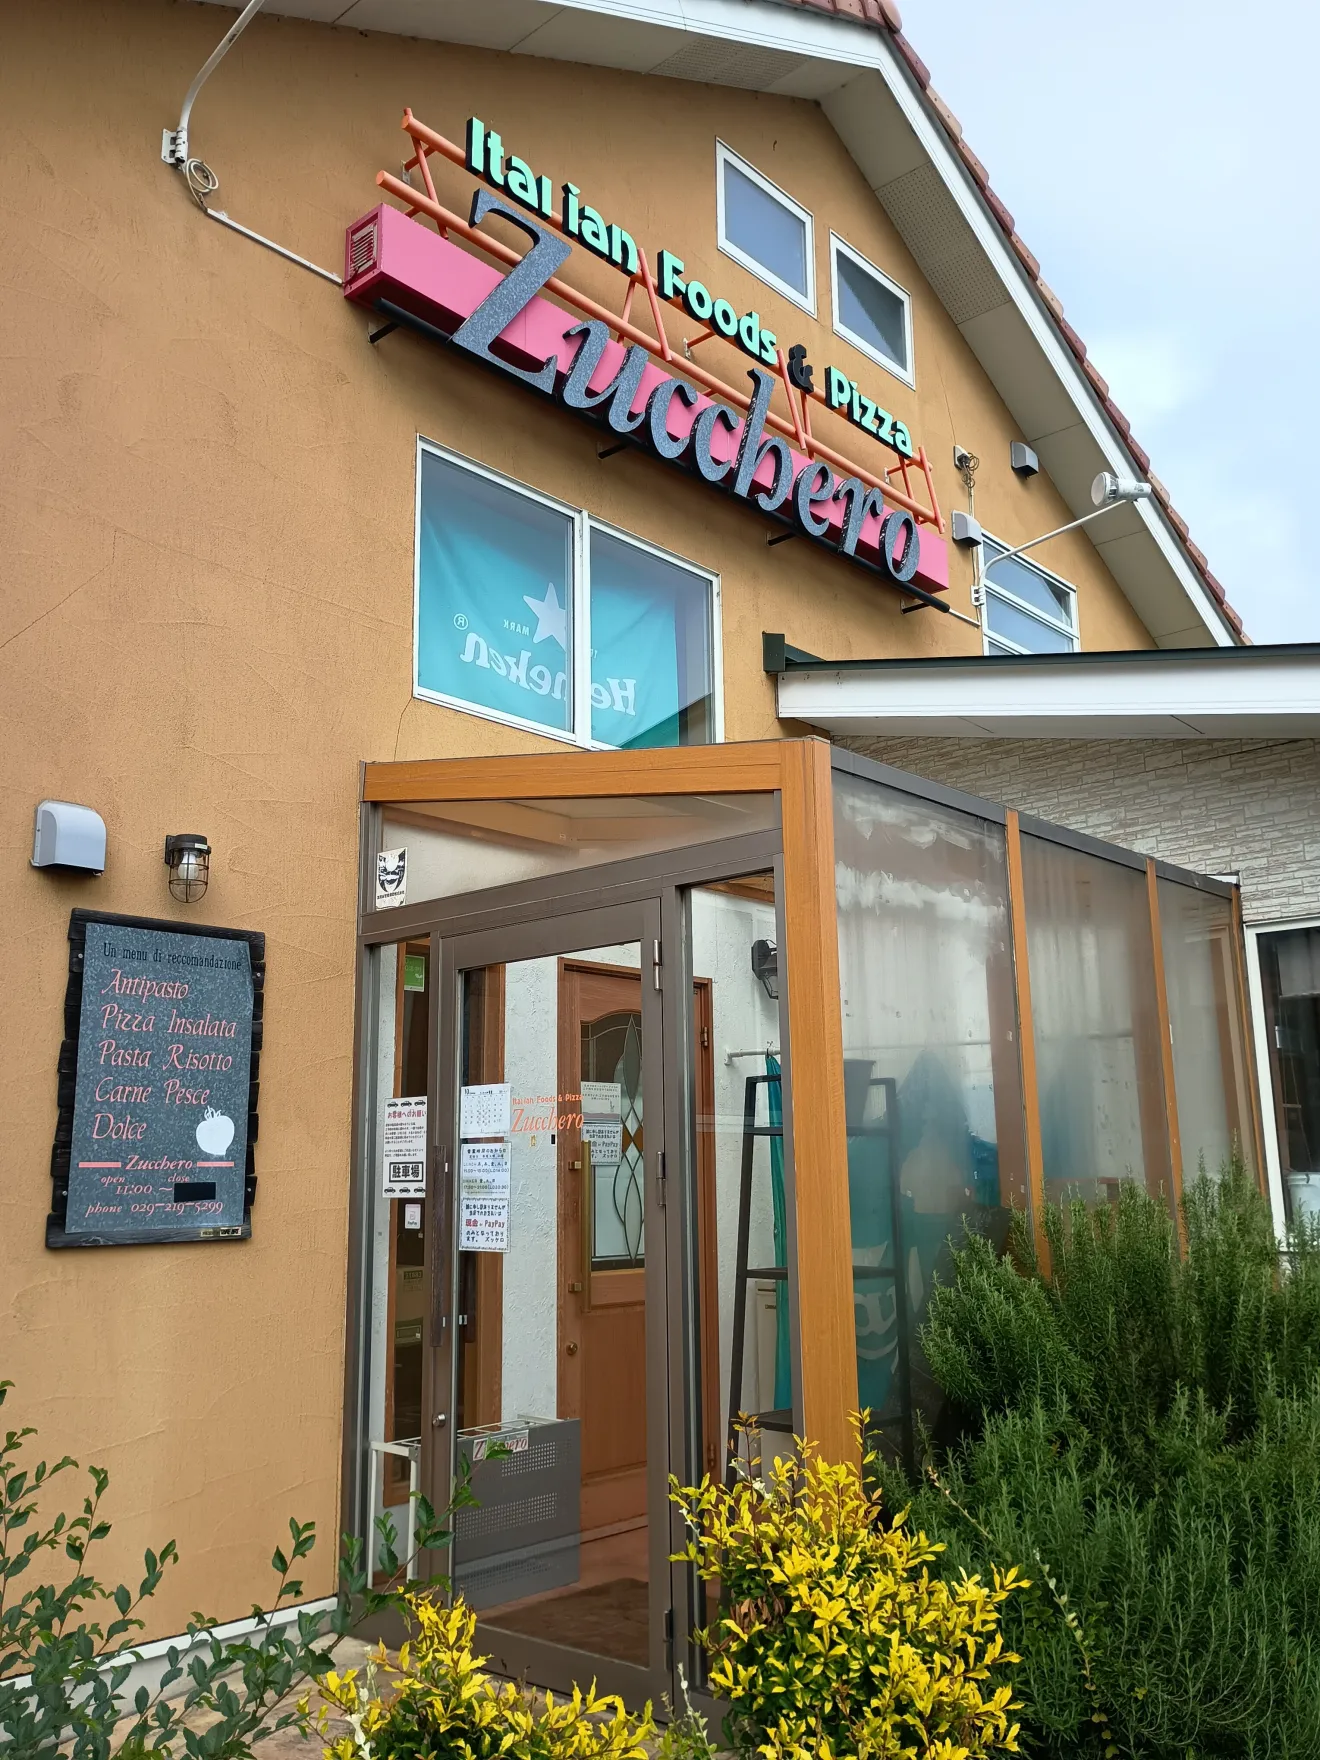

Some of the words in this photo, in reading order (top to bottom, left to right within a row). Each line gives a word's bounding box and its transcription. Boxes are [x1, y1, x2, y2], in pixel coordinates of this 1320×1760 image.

[466, 116, 640, 274] Italian
[657, 249, 779, 366] Foods
[788, 344, 814, 393] &
[825, 365, 913, 458] Pizza
[447, 187, 921, 582] Zucchero
[103, 942, 116, 958] Un
[122, 948, 147, 961] menu
[153, 949, 162, 963] di
[168, 954, 242, 971] reccomandazione
[100, 968, 189, 1004] Antipasto
[101, 1003, 155, 1032] Pizza
[167, 1009, 237, 1038] Insalata
[99, 1039, 151, 1067] Pasta
[162, 1044, 233, 1072] Risotto
[95, 1076, 151, 1104] Carne
[163, 1079, 210, 1105] Pesce
[536, 1095, 556, 1103] Foods
[558, 1094, 563, 1102] &
[565, 1093, 584, 1102] Pizza
[92, 1112, 147, 1140] Dolce
[511, 1107, 585, 1132] Zucchero
[125, 1155, 194, 1170] Zucchero
[392, 1164, 420, 1179] 駐車場
[100, 1175, 125, 1187] open
[115, 1184, 153, 1195] 11:00
[167, 1173, 190, 1183] close
[85, 1202, 123, 1218] phone
[131, 1200, 223, 1217] 029-219-5299
[484, 1219, 506, 1228] PayPay
